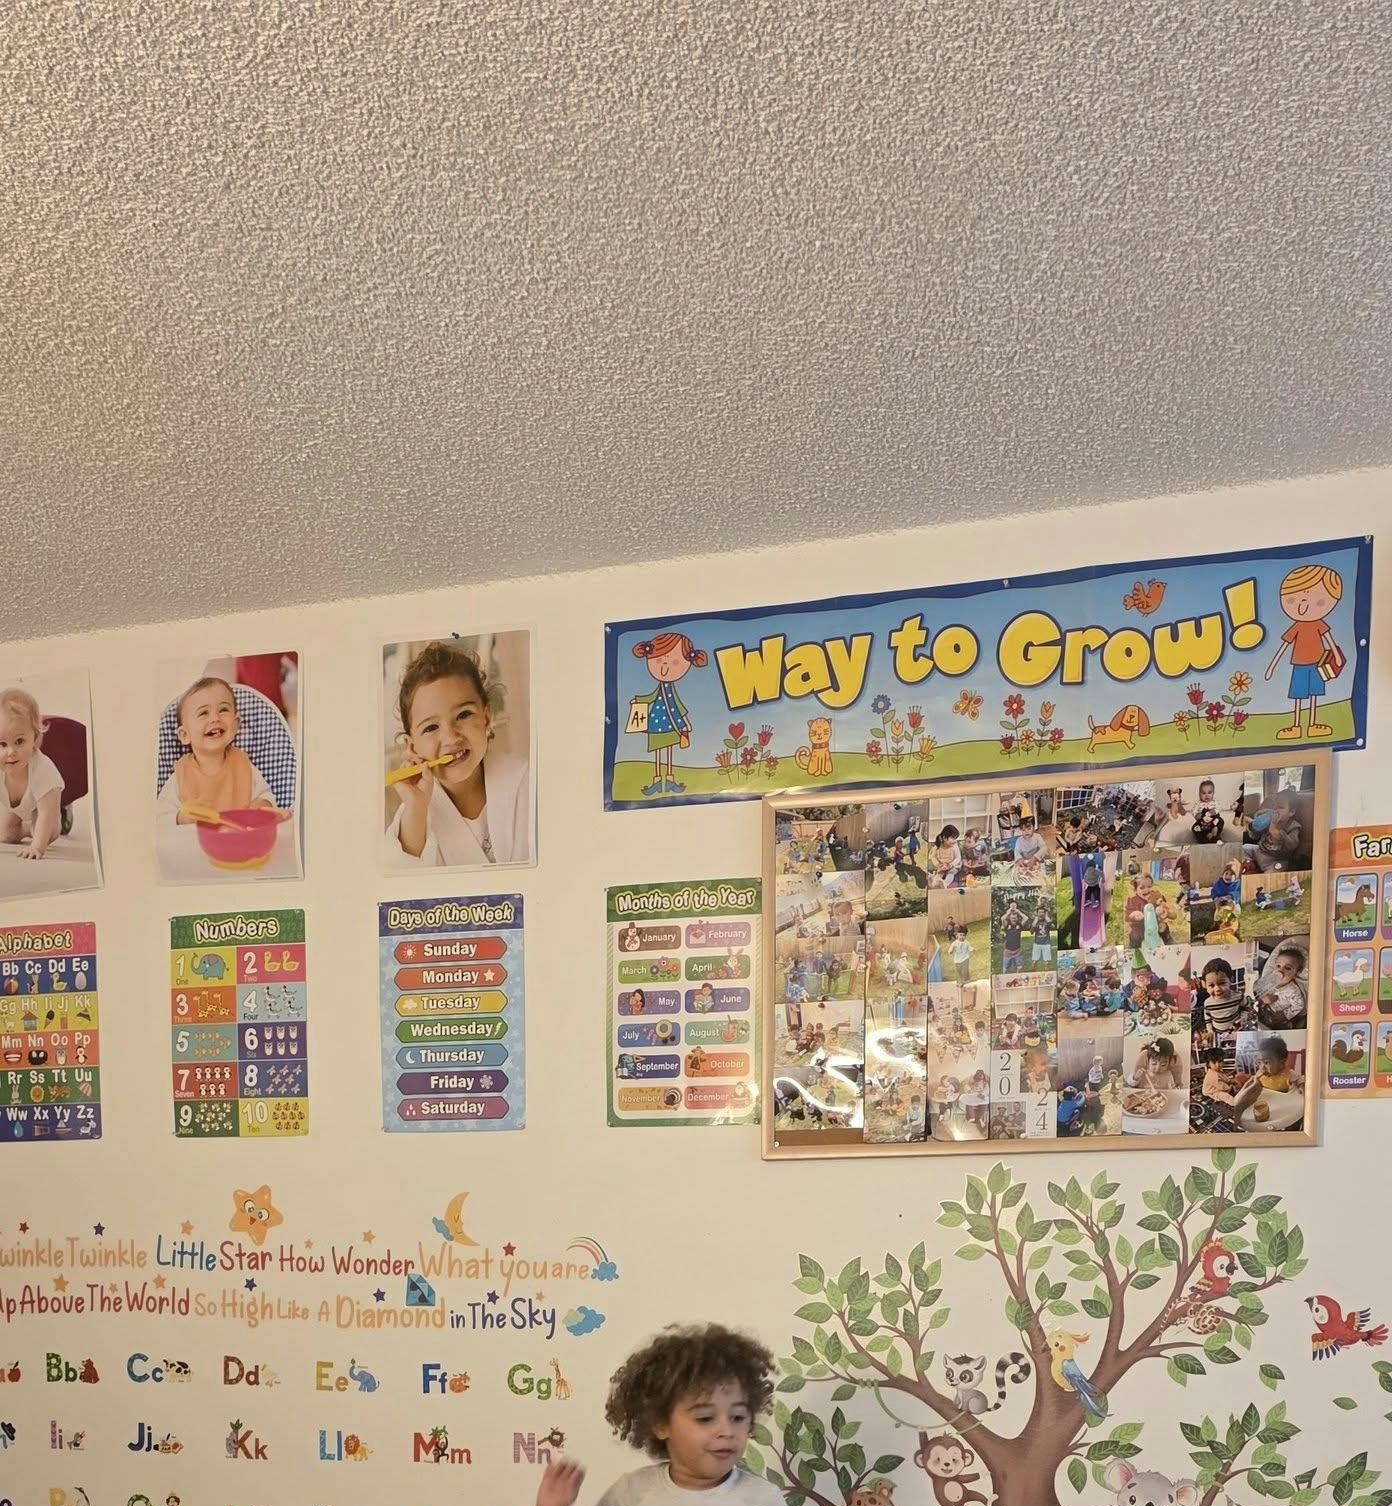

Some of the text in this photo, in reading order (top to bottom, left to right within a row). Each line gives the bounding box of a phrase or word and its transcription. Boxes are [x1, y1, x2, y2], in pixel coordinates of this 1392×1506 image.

[715, 578, 1267, 711] Way to Grow!
[631, 710, 647, 727] A+
[618, 887, 755, 913] Months of the Year
[390, 904, 513, 928] Days of the Week
[195, 917, 278, 942] Numbers
[642, 929, 747, 943] January February
[1342, 929, 1369, 938] Horse
[423, 943, 478, 957] Sunday
[2, 957, 89, 976] Bb Cc Dd Ee
[176, 951, 257, 977] 1 2
[622, 963, 713, 975] March April
[422, 970, 480, 984] Monday
[176, 991, 257, 1016] 3 4
[421, 996, 480, 1010] Tuesday
[658, 994, 742, 1007] May June
[1339, 1003, 1366, 1012] Sheep
[243, 1013, 258, 1021] Four
[411, 1022, 493, 1037] Wednesday
[622, 1028, 720, 1041] July August
[176, 1028, 258, 1052] 5 6
[420, 1049, 485, 1063] Thursday
[636, 1059, 745, 1072] September October
[178, 1065, 258, 1090] 7 8
[430, 1075, 475, 1090] Friday
[1333, 1076, 1366, 1086] Rooster
[621, 1093, 730, 1103] November December
[76, 1105, 95, 1119] Zz
[179, 1101, 268, 1127] 9 10
[421, 1101, 485, 1115] Saturday
[0, 1235, 589, 1297] winkle Twinkle Little Star How Wonder What you are
[20, 1281, 556, 1340] Above The World So High Like A Diamond in The Sky
[46, 1352, 552, 1400] Bb Cc Dd Ee Ff Gg
[127, 1422, 153, 1452] Jj
[233, 1430, 268, 1460] Kk
[413, 1432, 472, 1464] Mm
[513, 1432, 552, 1464] Nn
